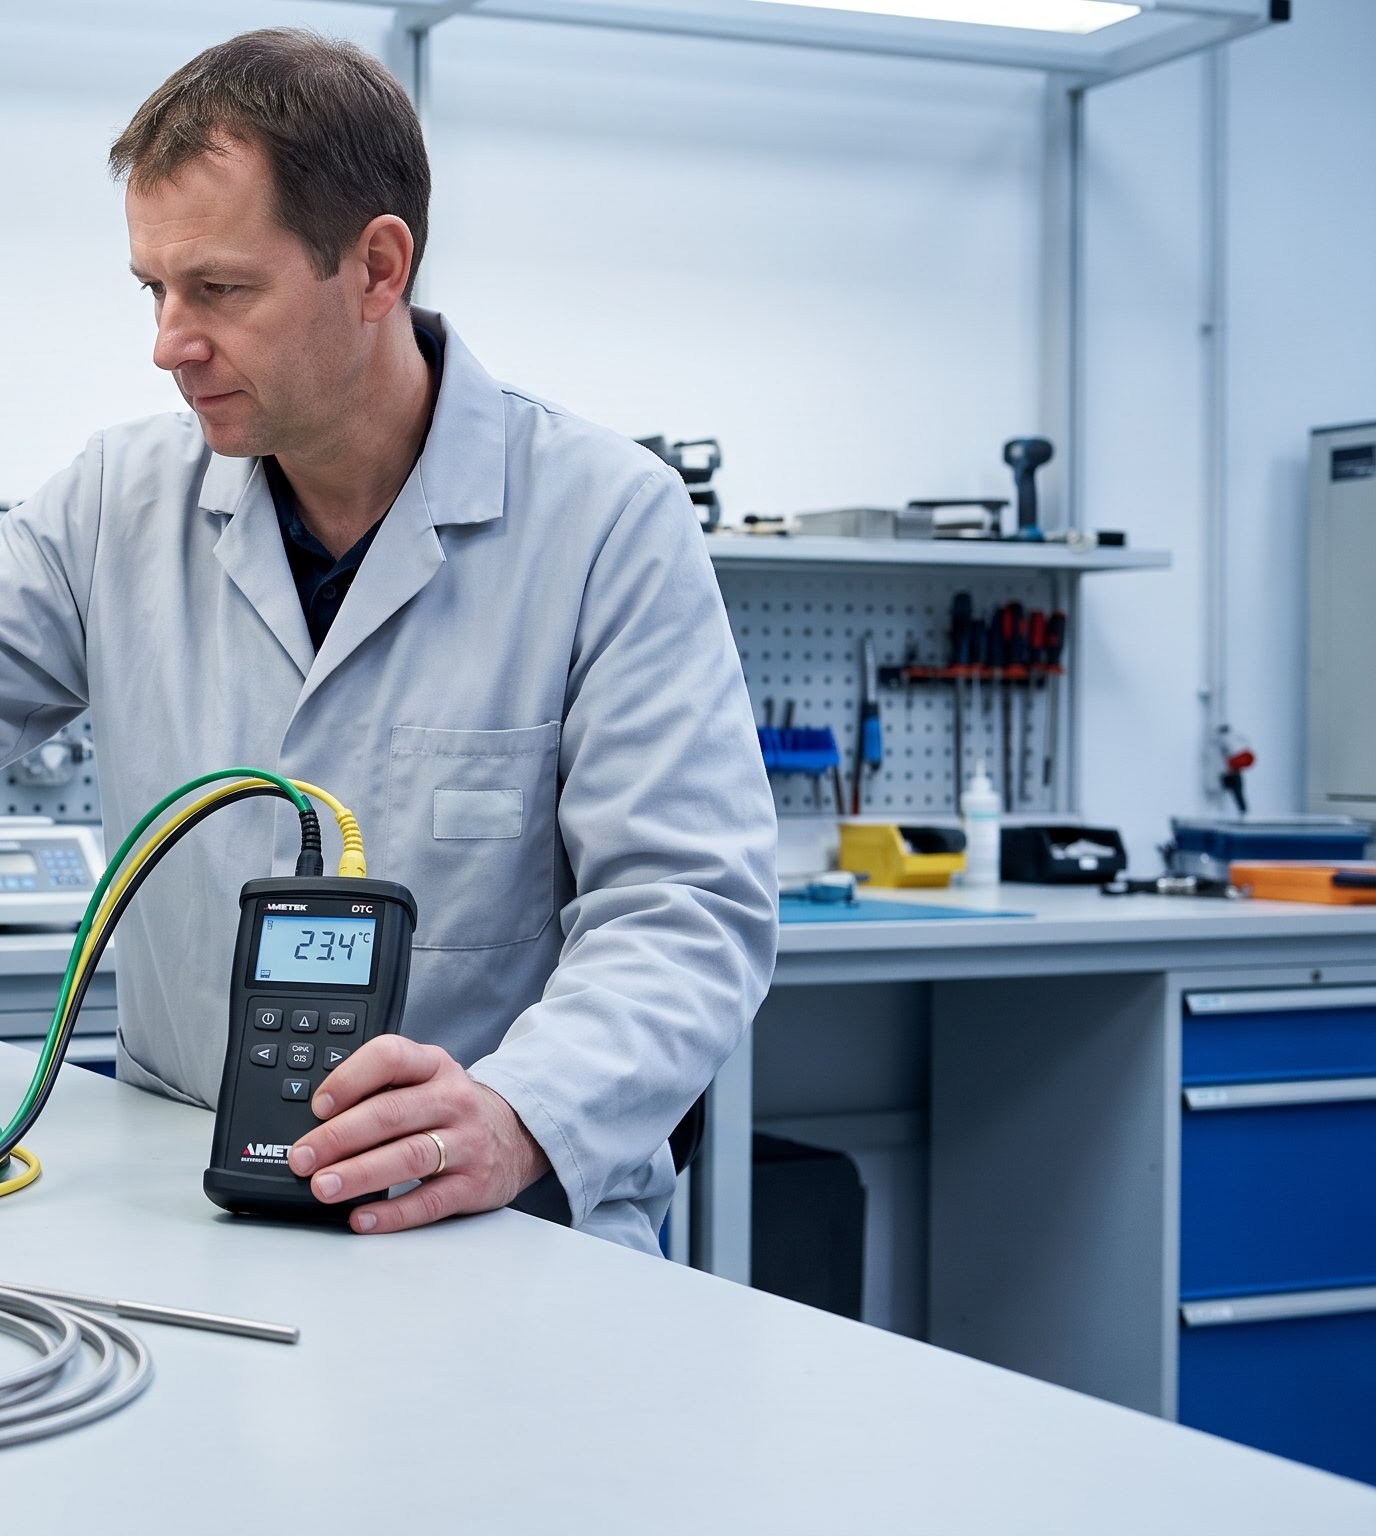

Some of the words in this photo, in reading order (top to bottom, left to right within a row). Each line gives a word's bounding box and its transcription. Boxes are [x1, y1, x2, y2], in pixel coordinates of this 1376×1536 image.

[351, 905, 373, 913] DTC
[294, 930, 356, 961] 23.4
[359, 932, 371, 943] °C
